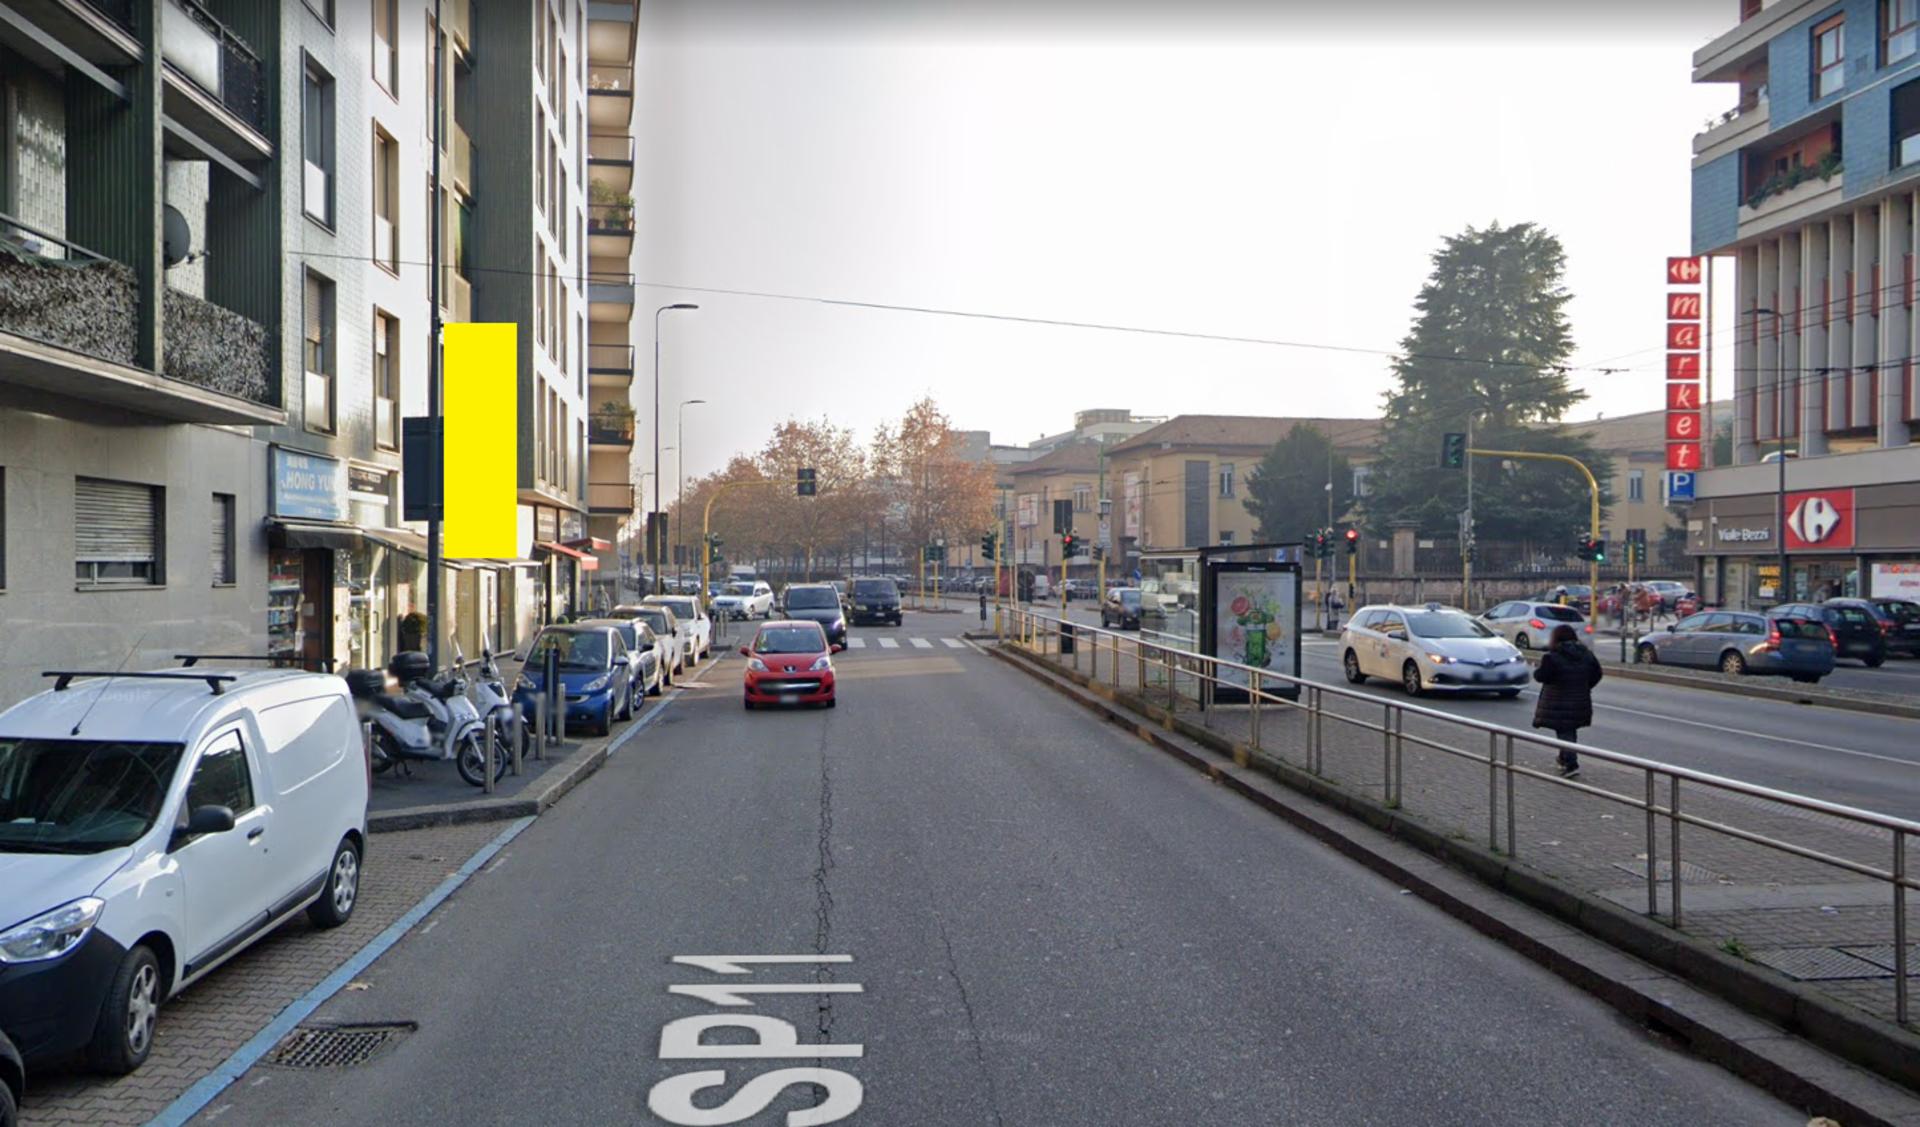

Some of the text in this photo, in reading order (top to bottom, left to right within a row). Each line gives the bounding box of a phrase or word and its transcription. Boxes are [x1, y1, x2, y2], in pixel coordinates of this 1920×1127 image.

[1671, 295, 1699, 468] market
[1673, 472, 1690, 492] P
[1718, 527, 1769, 541] Viale Bezzi
